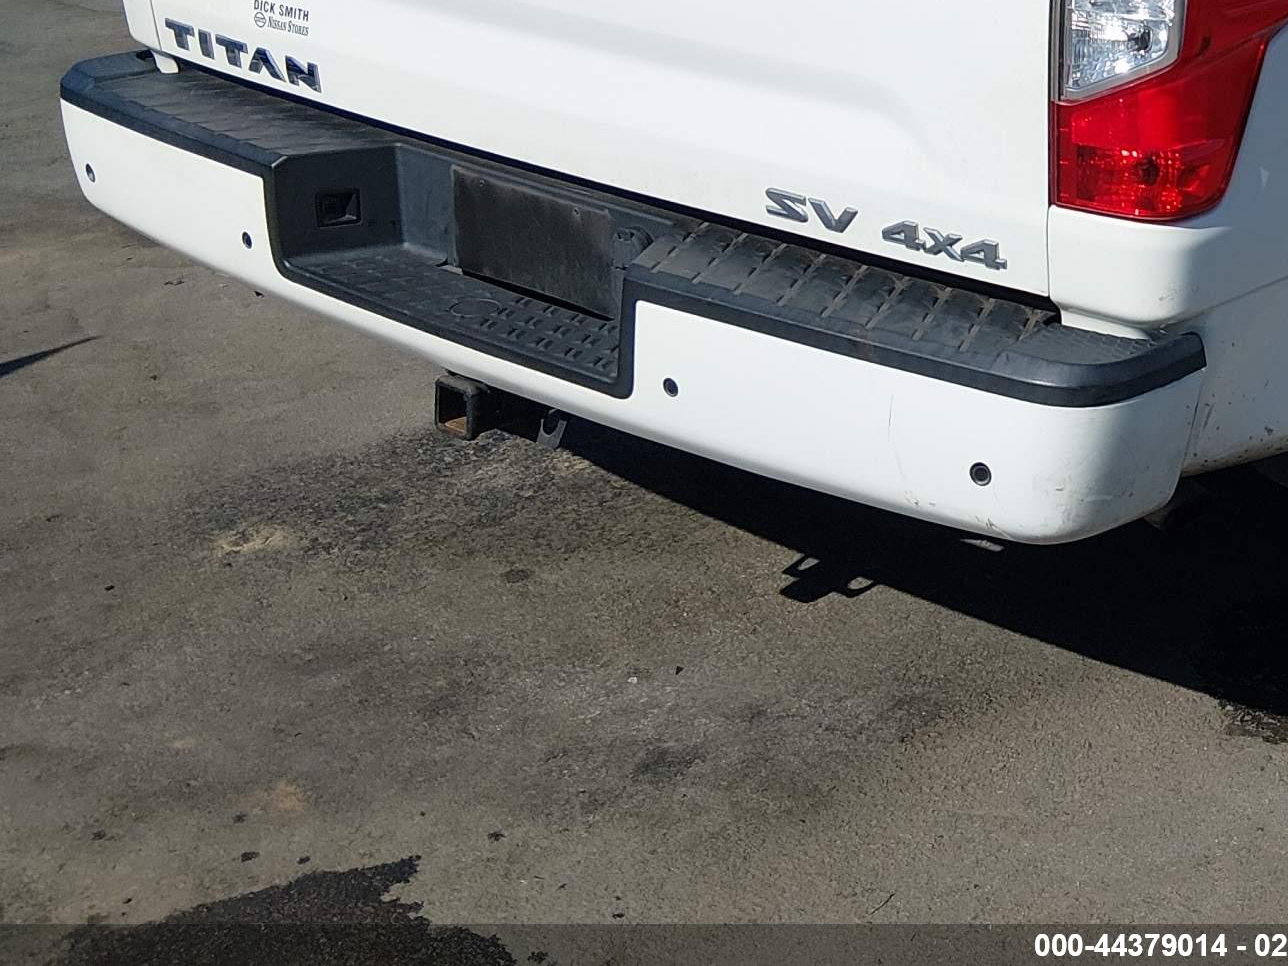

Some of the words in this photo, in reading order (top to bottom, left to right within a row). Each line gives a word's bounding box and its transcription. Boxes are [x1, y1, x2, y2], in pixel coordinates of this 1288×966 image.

[279, 4, 309, 22] SMITH
[165, 17, 322, 93] TITAN
[766, 187, 858, 233] SV
